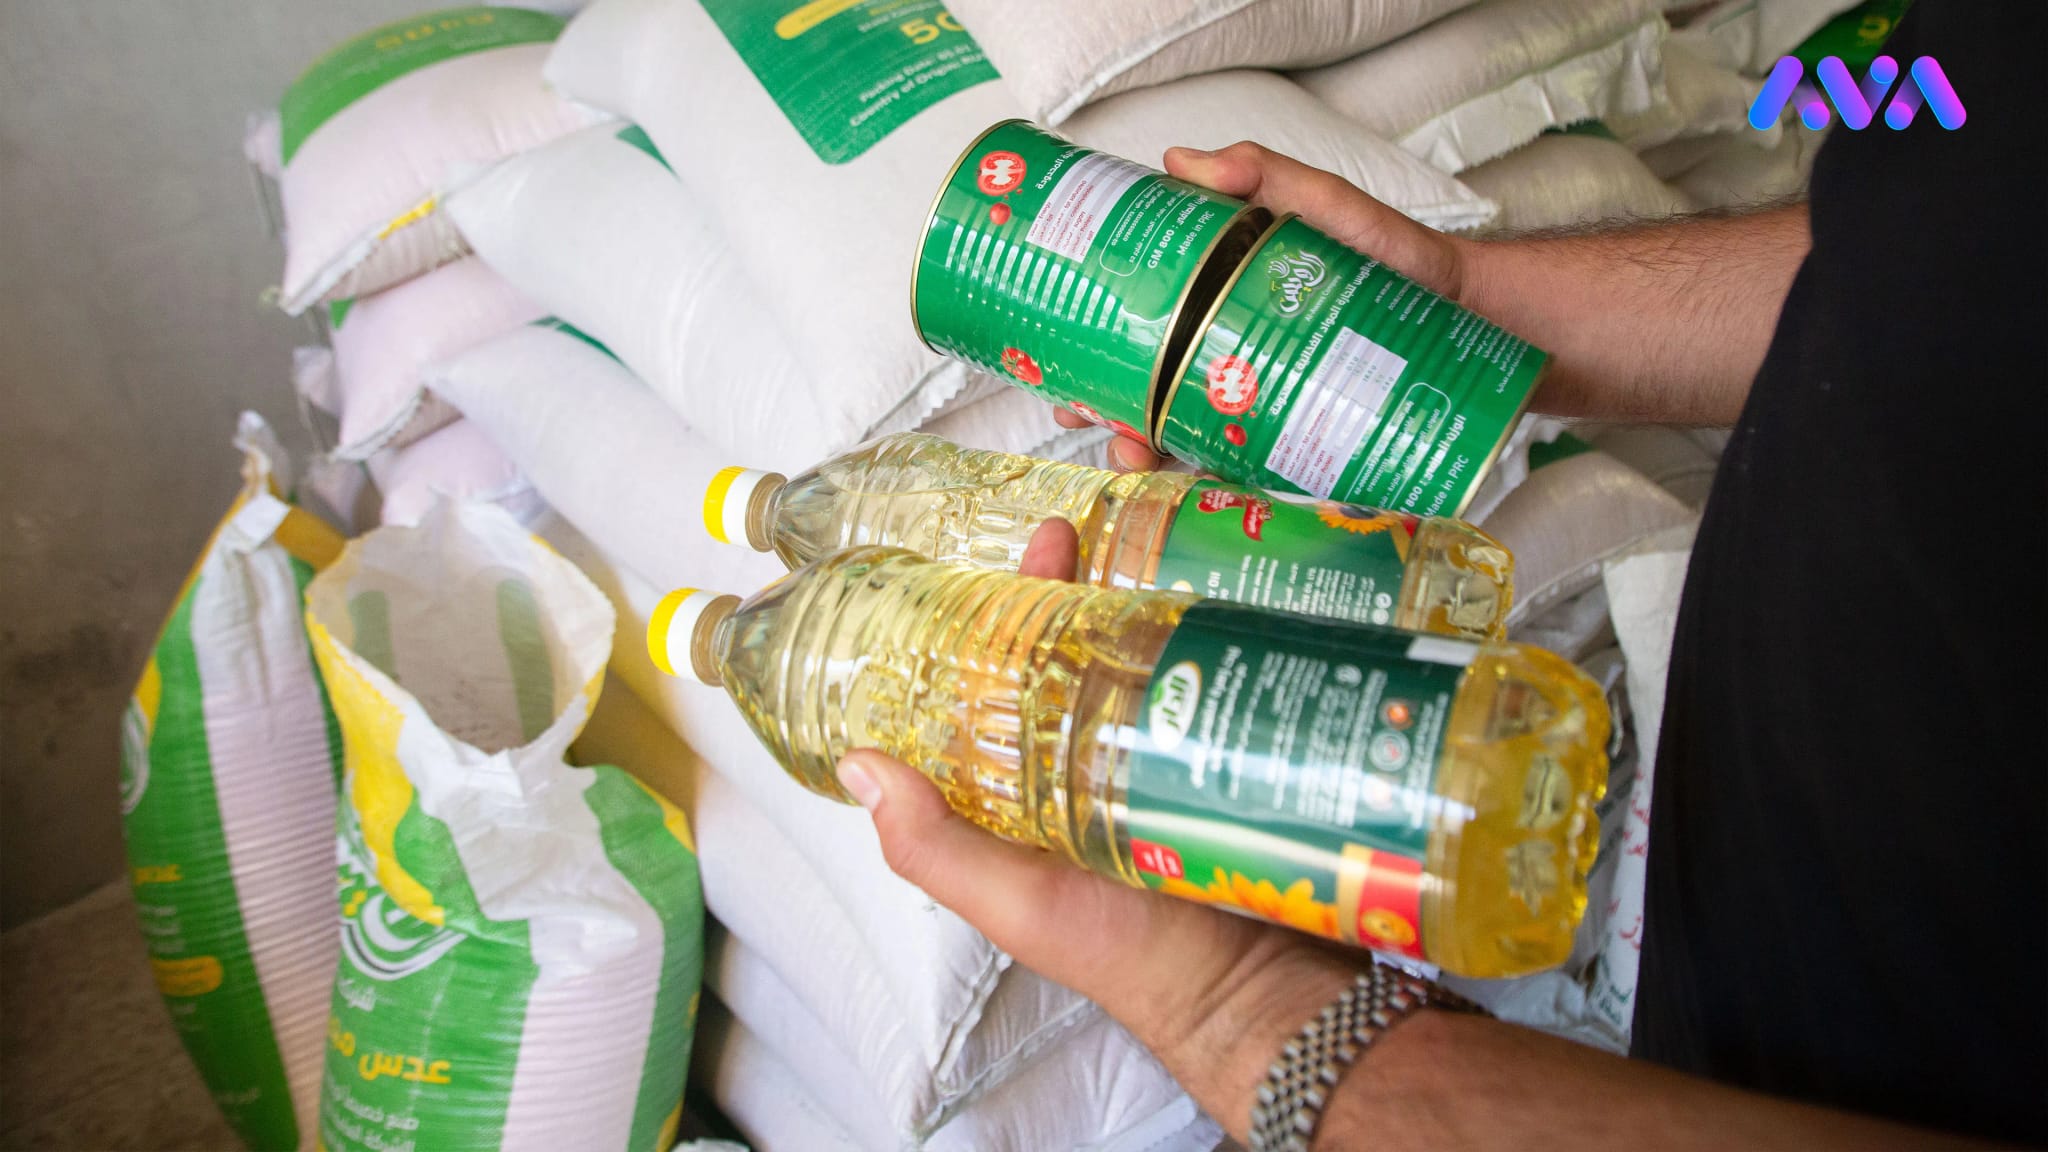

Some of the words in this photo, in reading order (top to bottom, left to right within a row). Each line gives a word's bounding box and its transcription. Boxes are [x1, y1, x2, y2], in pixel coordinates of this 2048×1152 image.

[848, 88, 900, 128] Country
[1192, 221, 1204, 232] in
[1197, 208, 1215, 225] PRC
[1176, 230, 1197, 256] Made
[1145, 247, 1164, 270] GM
[1318, 304, 1342, 334] المواد
[1294, 330, 1324, 372] الغذائية
[1443, 412, 1469, 442] الوزن
[1441, 477, 1455, 491] in
[1448, 453, 1469, 479] PRC
[1404, 484, 1423, 507] 800
[1158, 674, 1190, 730] الدار
[358, 1051, 452, 1085] عدس
